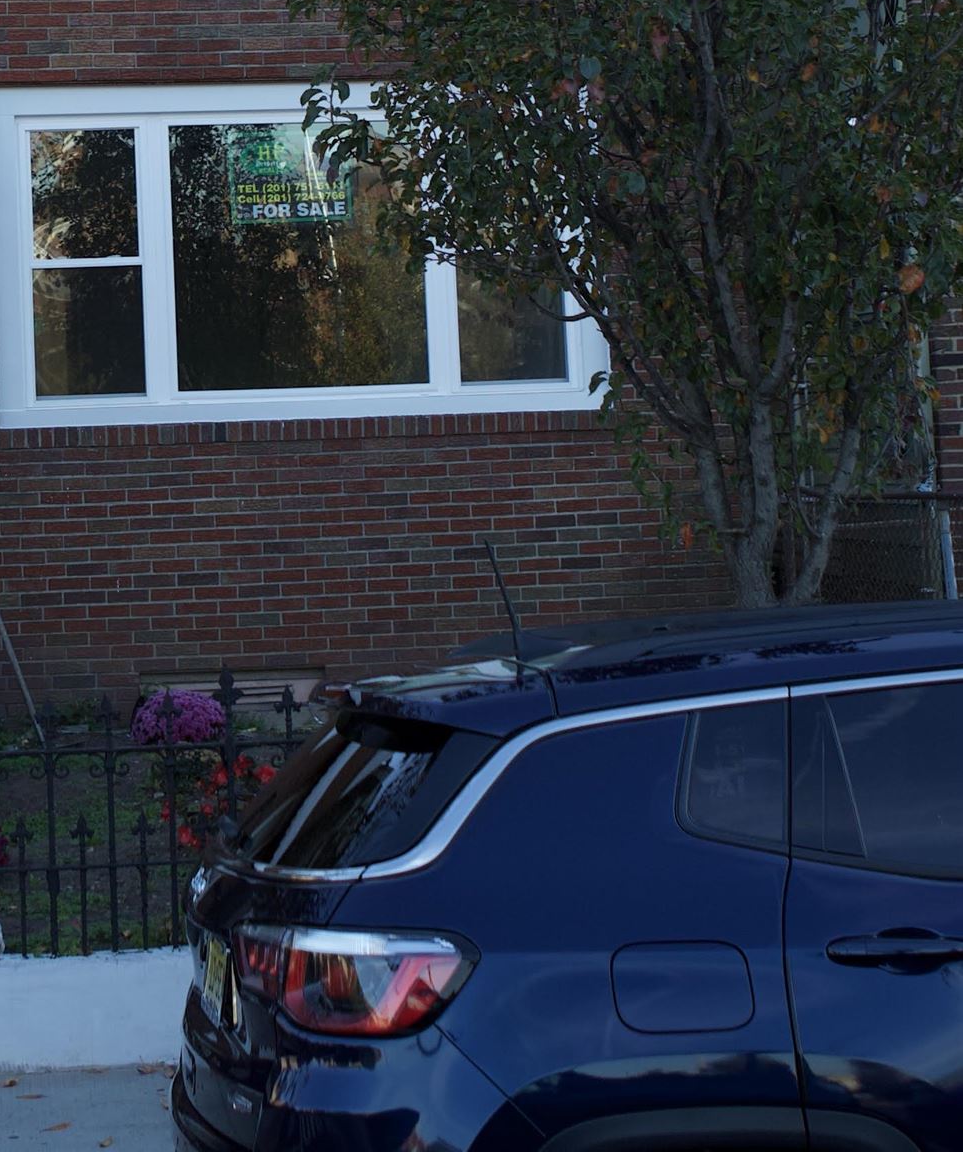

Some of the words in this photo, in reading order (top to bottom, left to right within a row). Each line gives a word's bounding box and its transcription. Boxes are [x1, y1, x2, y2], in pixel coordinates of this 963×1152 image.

[237, 184, 259, 193] TEL
[263, 183, 291, 193] (201)
[252, 204, 291, 219] FOR
[296, 202, 346, 217] SALE
